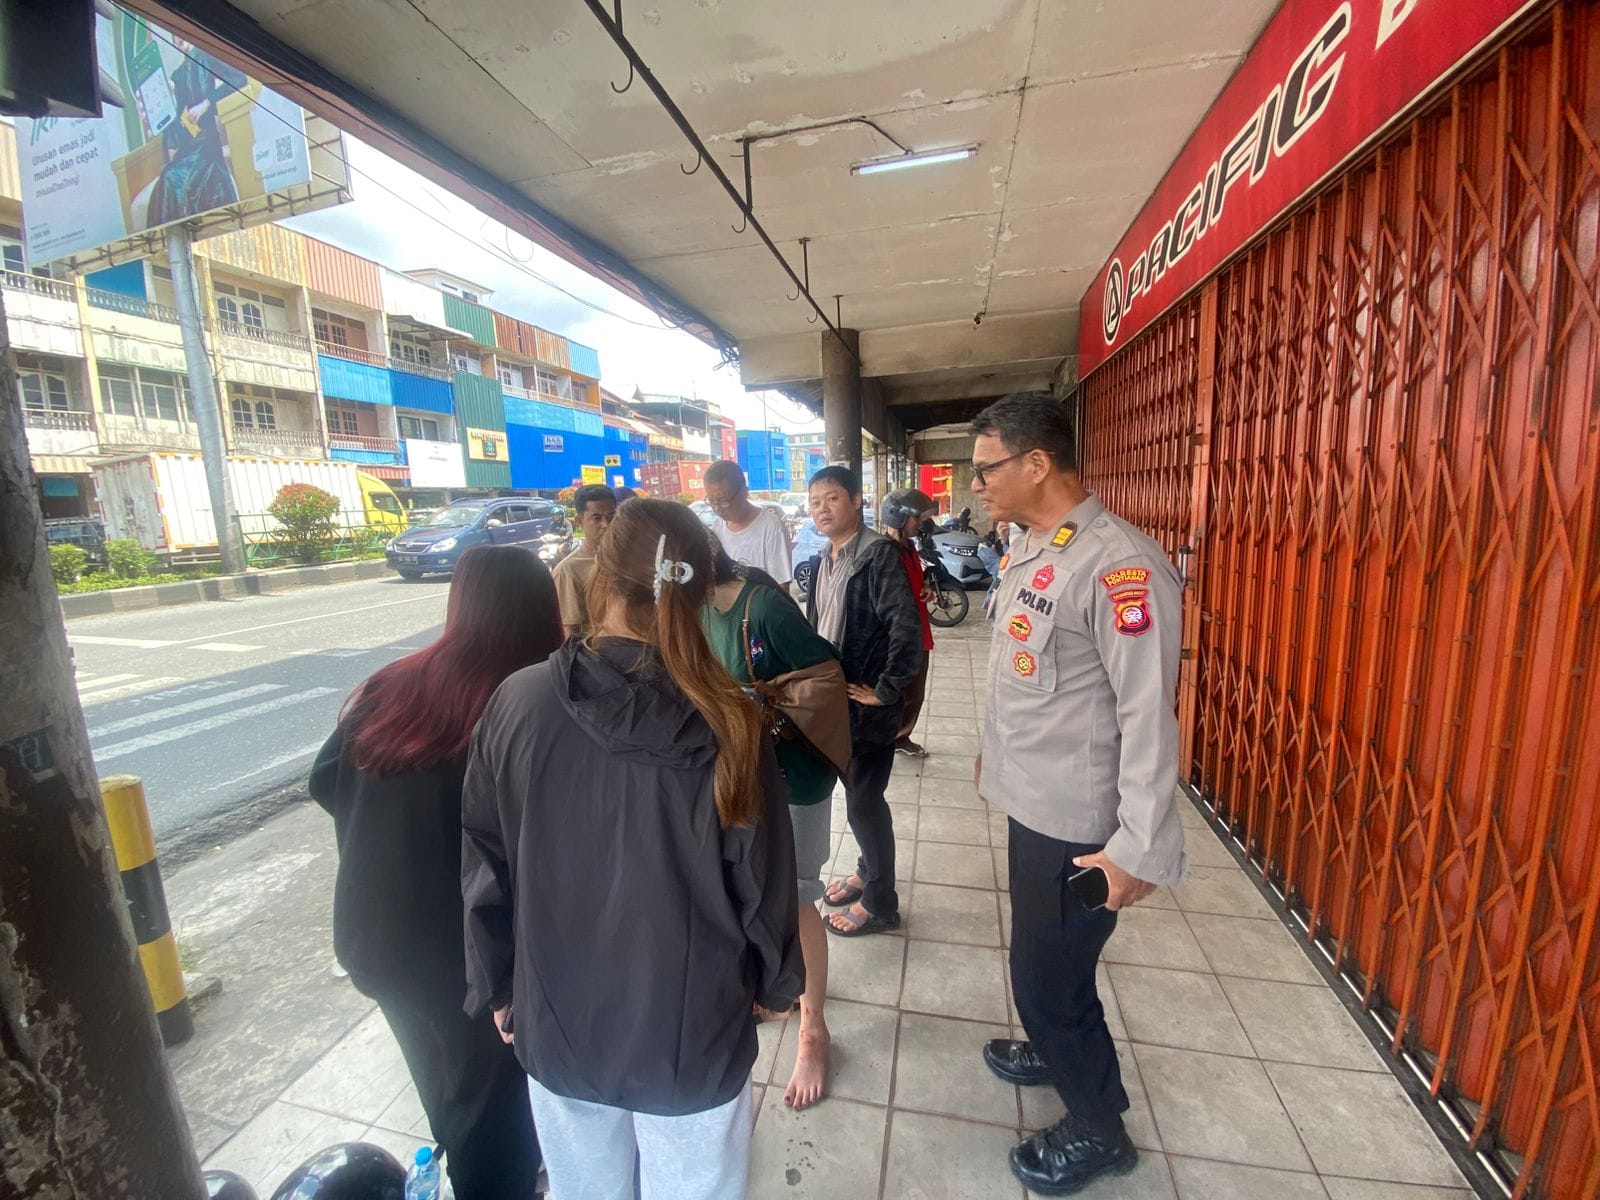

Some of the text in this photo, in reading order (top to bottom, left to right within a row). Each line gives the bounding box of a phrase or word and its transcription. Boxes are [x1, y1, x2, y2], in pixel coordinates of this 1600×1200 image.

[32, 128, 96, 166] Urusan emas jadi
[33, 147, 99, 183] mudah dan cepat
[1123, 1, 1351, 317] PACIFIC
[1017, 587, 1053, 616] POLRI
